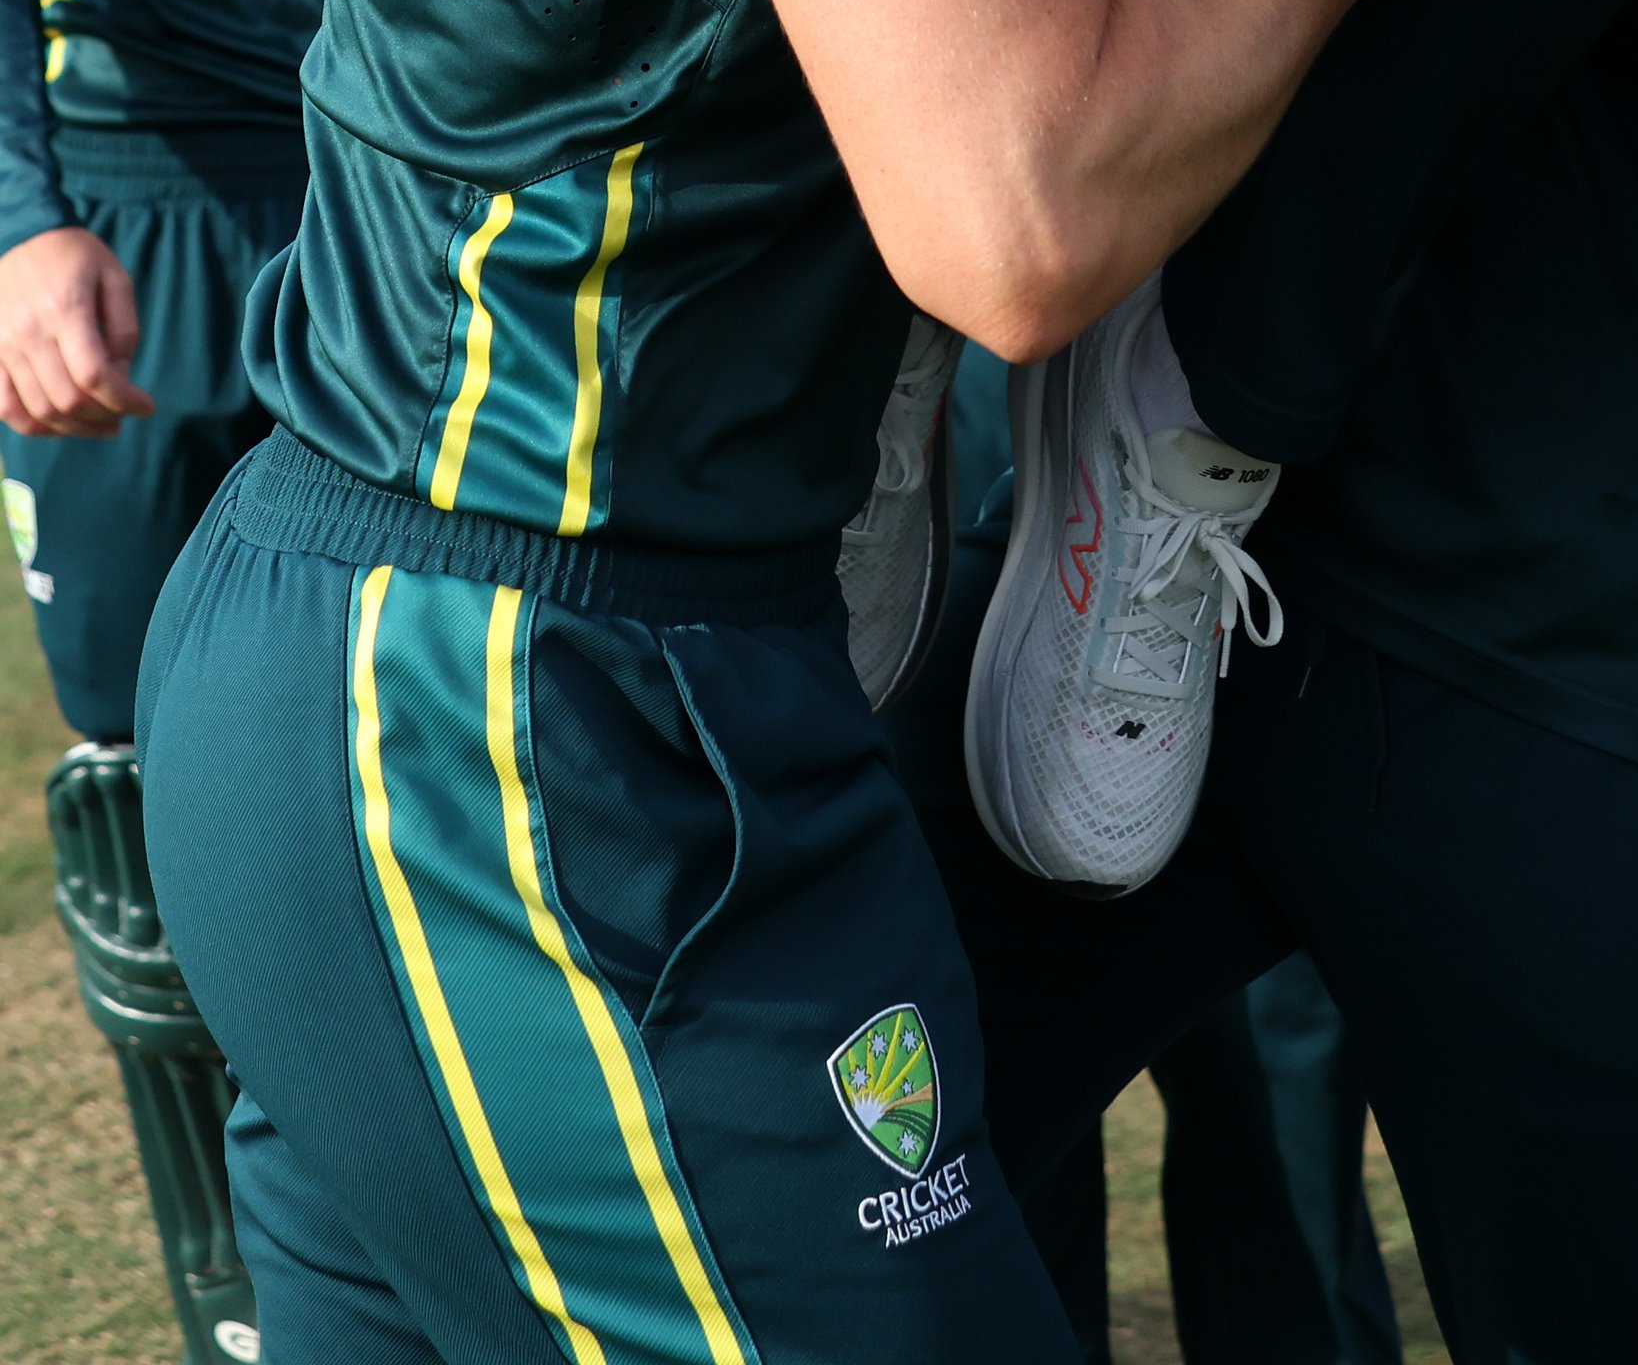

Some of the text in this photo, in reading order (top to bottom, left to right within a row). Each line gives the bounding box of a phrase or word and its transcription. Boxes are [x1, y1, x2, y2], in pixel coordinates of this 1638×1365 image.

[1238, 468, 1270, 484] 1080
[857, 1153, 970, 1230] CRICKET
[885, 1193, 972, 1249] AUSTRALIA
